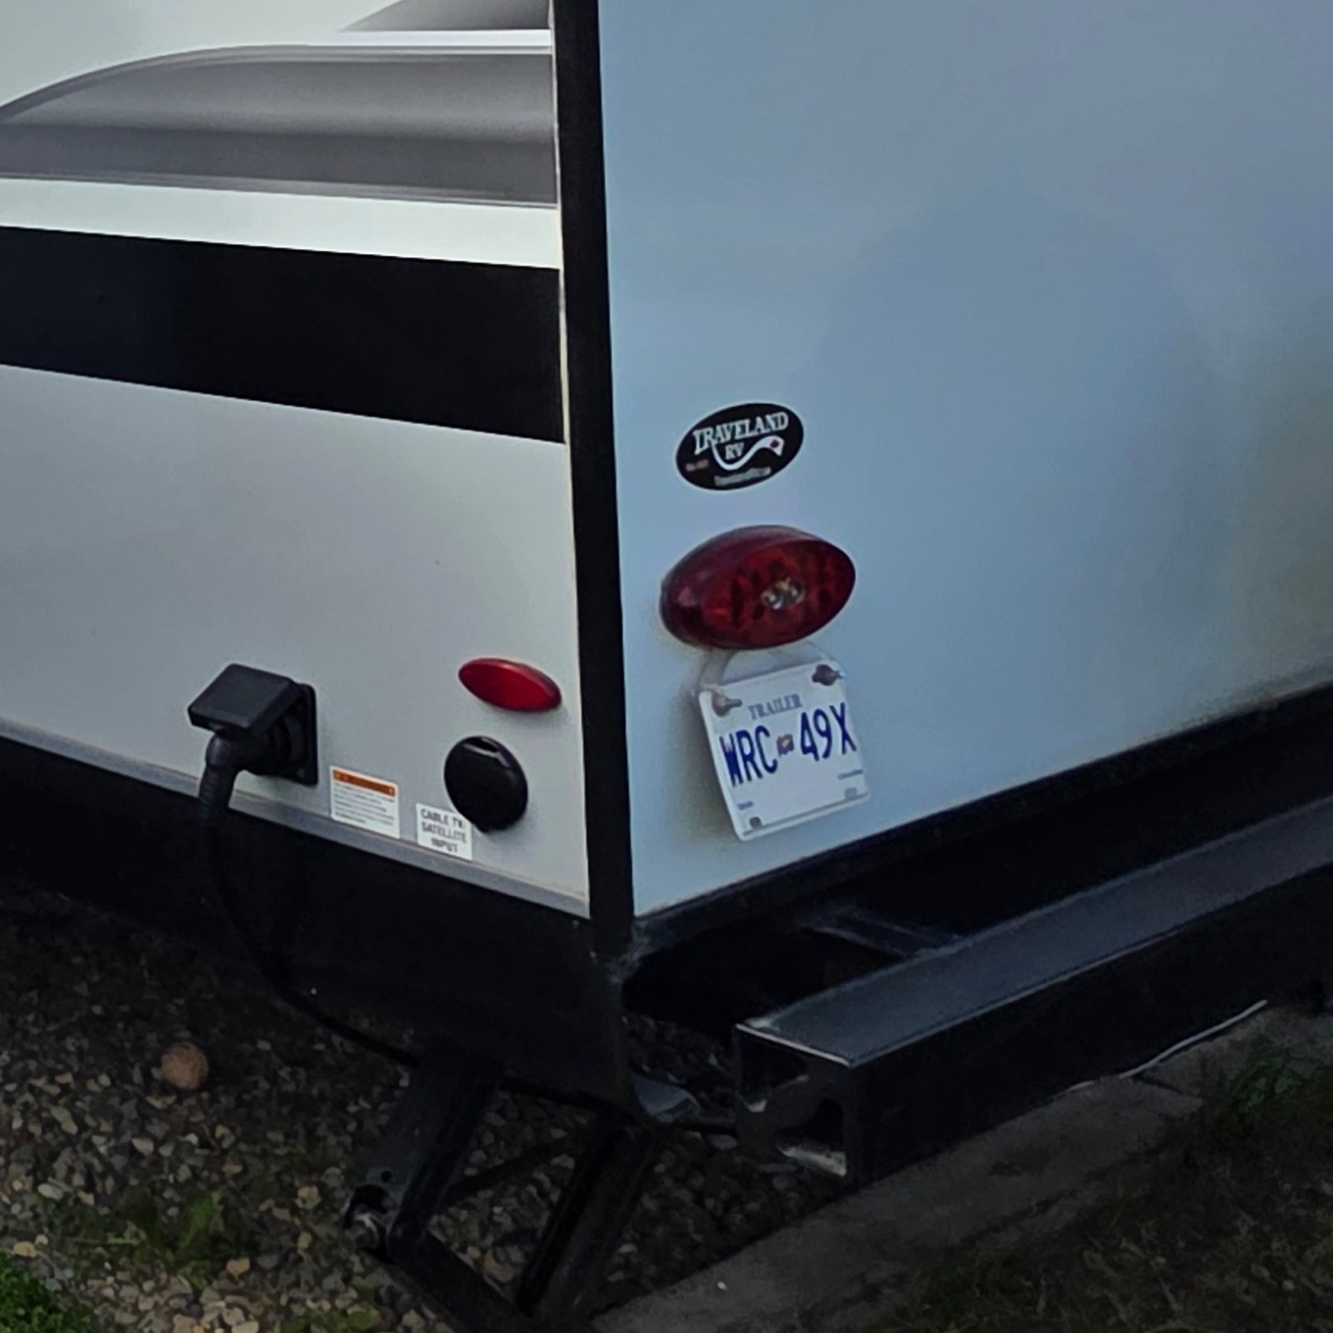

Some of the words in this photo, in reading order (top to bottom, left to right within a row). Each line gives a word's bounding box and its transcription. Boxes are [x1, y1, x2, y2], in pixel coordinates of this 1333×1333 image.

[693, 411, 789, 455] TRAVELAND
[725, 442, 744, 460] RV
[748, 693, 803, 719] TRAILER
[719, 724, 779, 788] WRC
[800, 702, 857, 762] 49X
[421, 821, 467, 844] SATELLITE
